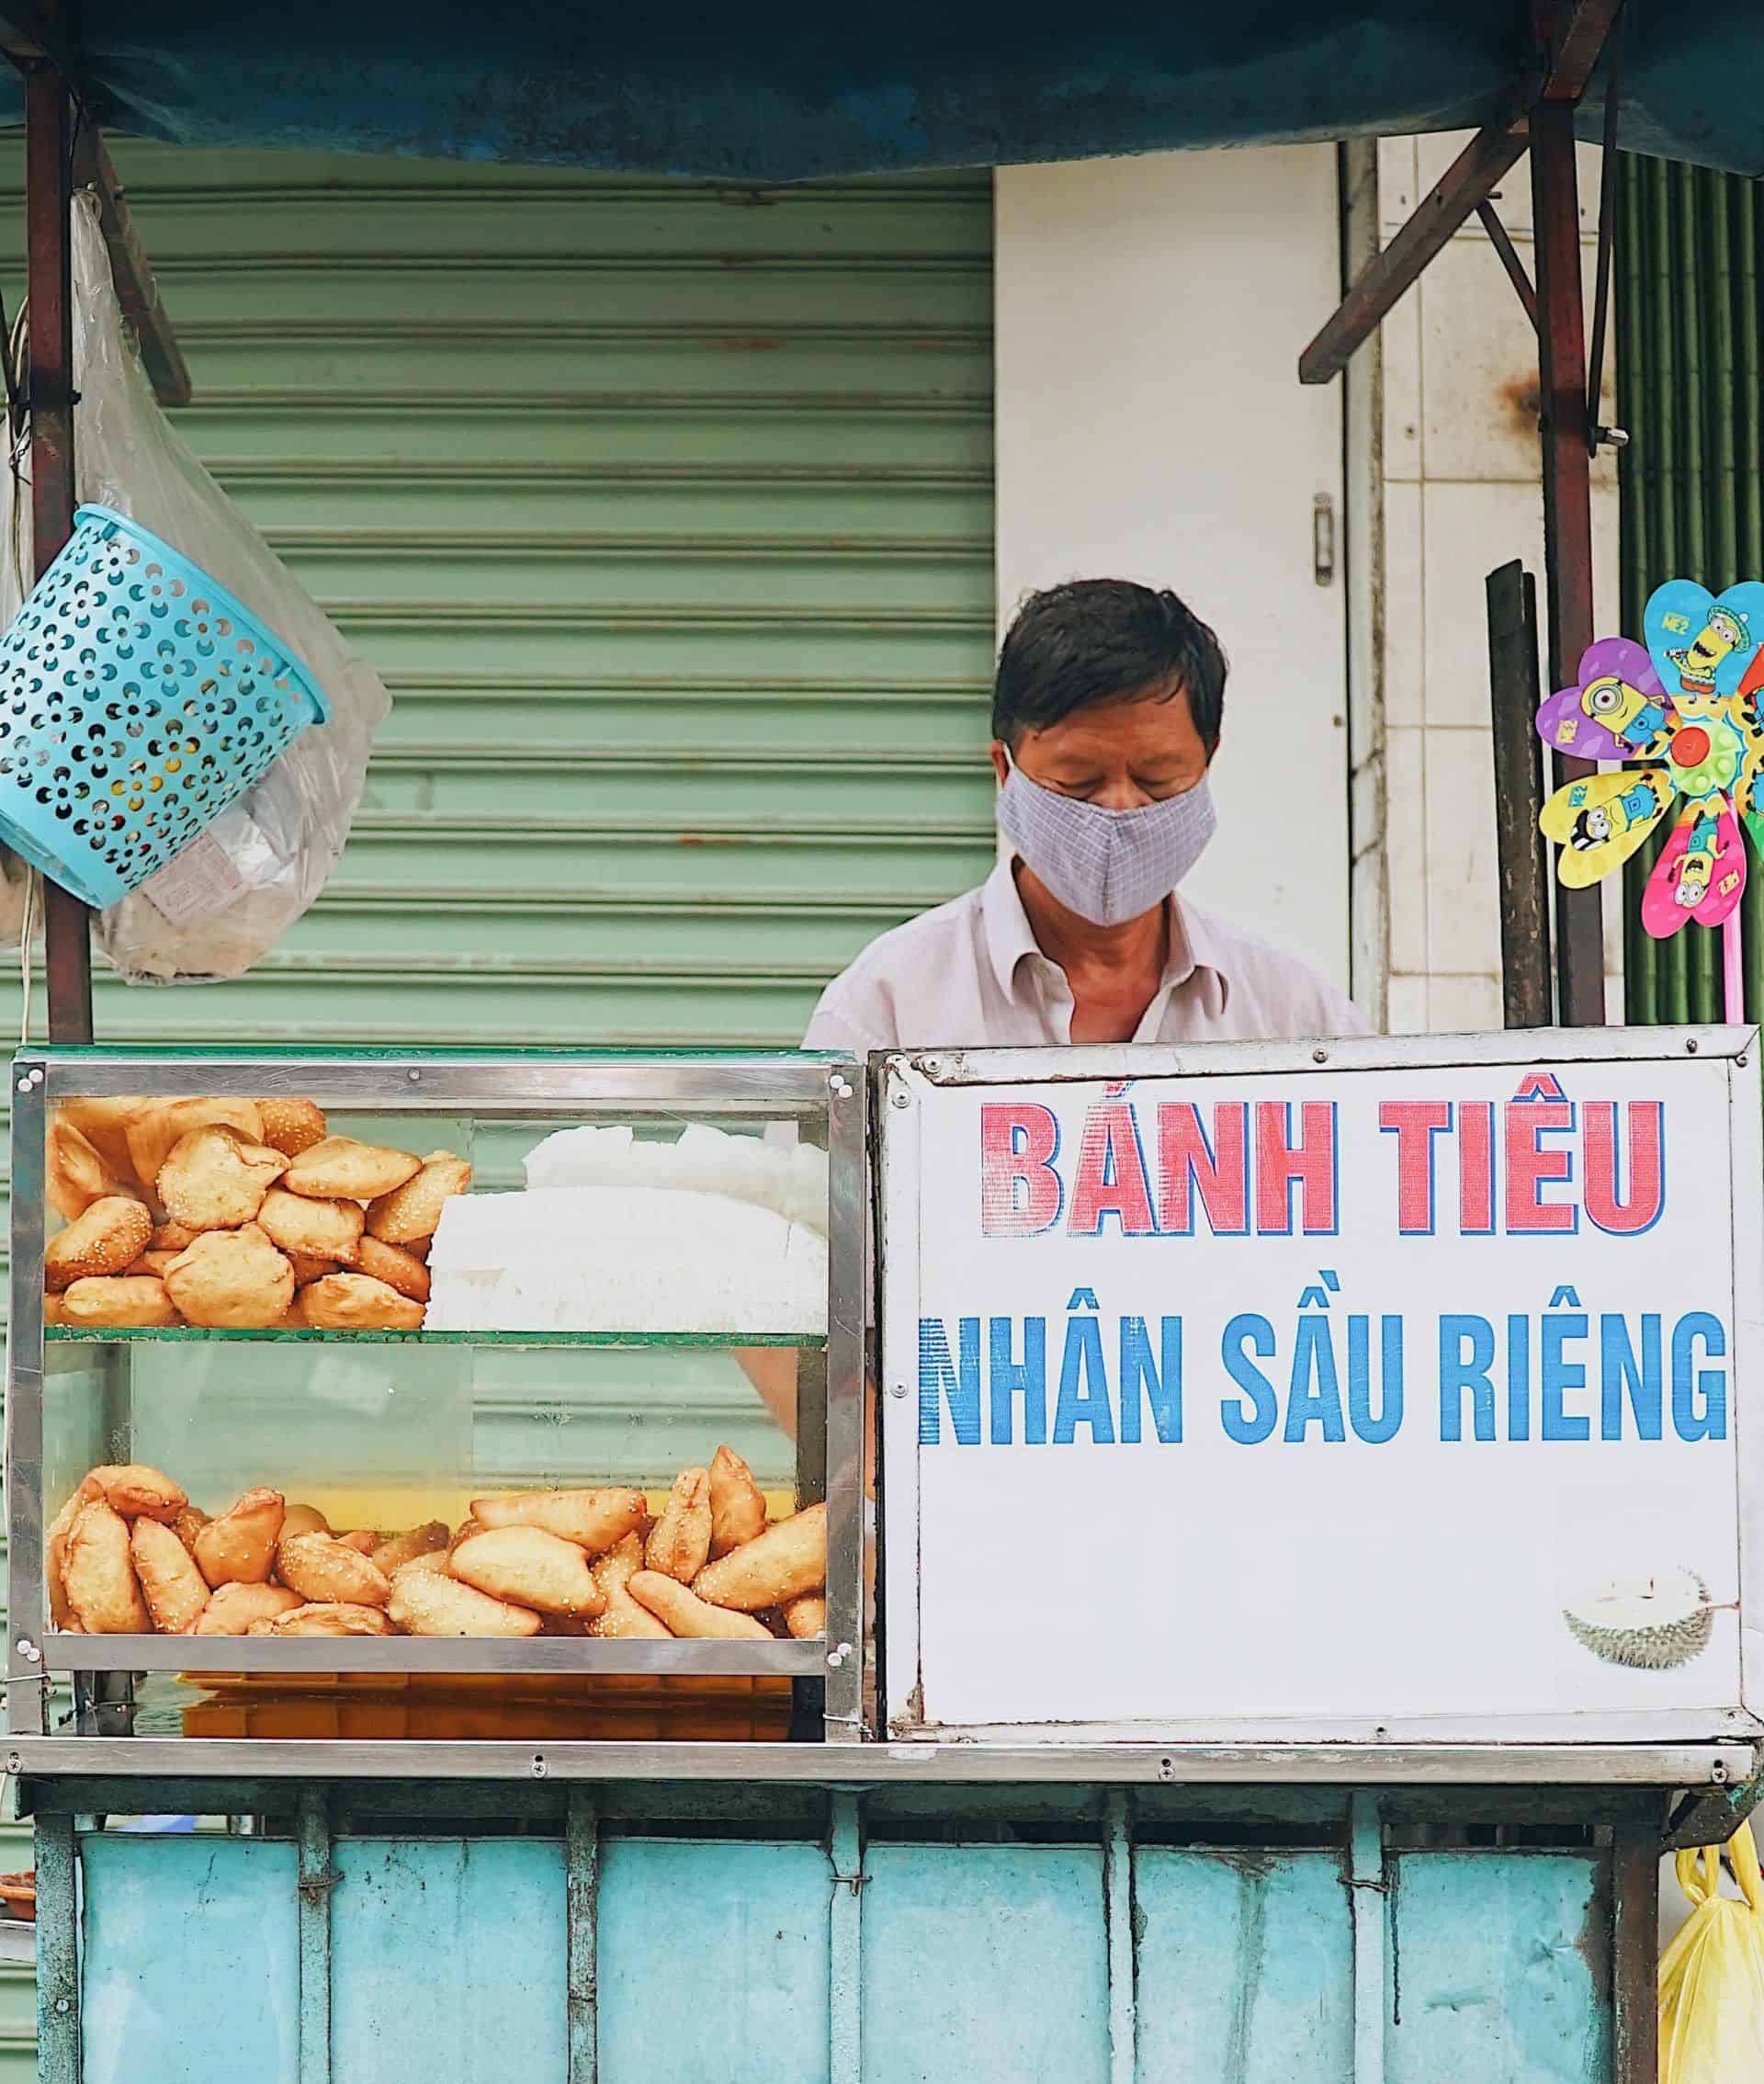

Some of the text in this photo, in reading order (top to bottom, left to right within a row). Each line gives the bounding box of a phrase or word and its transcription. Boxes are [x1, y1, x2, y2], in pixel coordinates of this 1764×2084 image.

[981, 1073, 1667, 1239] BÁNH TIÊU
[919, 1269, 1727, 1446] NHÂN SẦU RIÊNG
